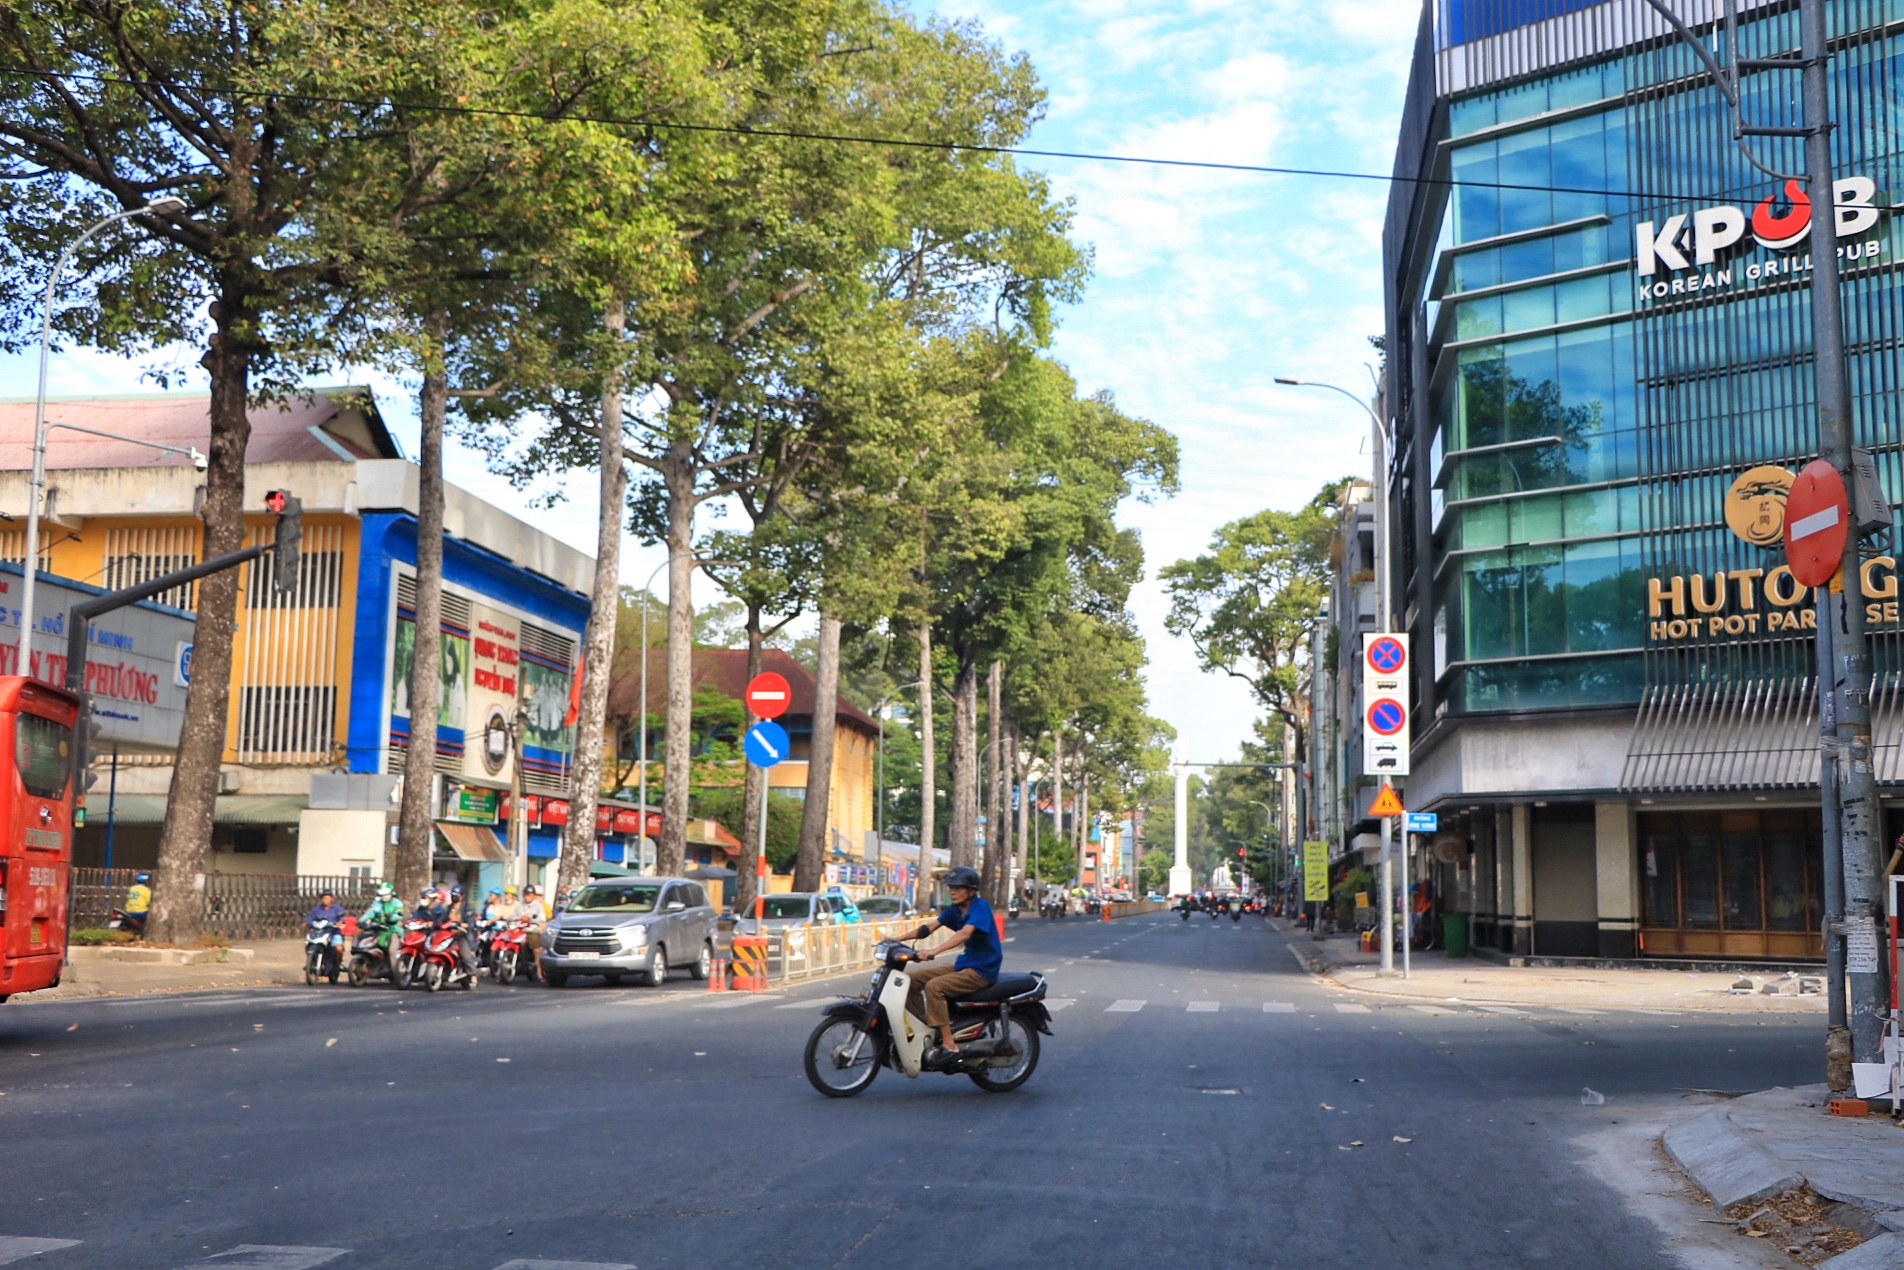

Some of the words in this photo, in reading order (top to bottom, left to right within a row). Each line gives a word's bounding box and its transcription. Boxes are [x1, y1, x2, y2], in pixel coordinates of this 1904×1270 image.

[1639, 269, 1731, 300] KOREAN
[1648, 556, 1898, 618] HUTOG
[98, 629, 134, 650] MINH
[1651, 619, 1702, 641] HOT
[1709, 614, 1760, 637] POT
[83, 660, 159, 704] PHƯƠNG
